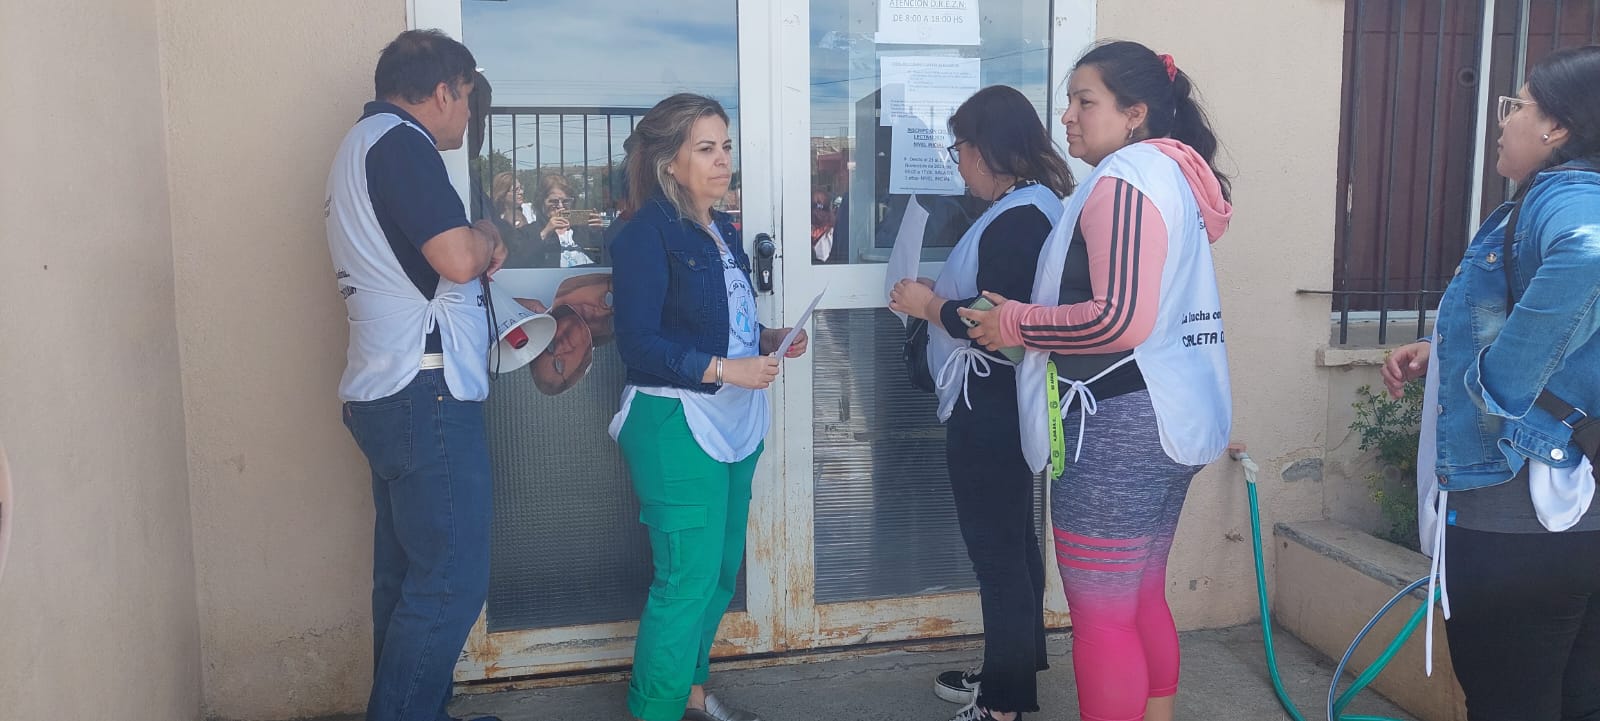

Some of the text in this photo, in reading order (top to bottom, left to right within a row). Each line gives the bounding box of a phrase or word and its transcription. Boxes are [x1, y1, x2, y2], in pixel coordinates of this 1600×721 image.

[893, 14, 964, 24] DE 8:00 A 18:00 HS
[1188, 310, 1211, 323] lucha
[1182, 331, 1218, 348] CALETA
